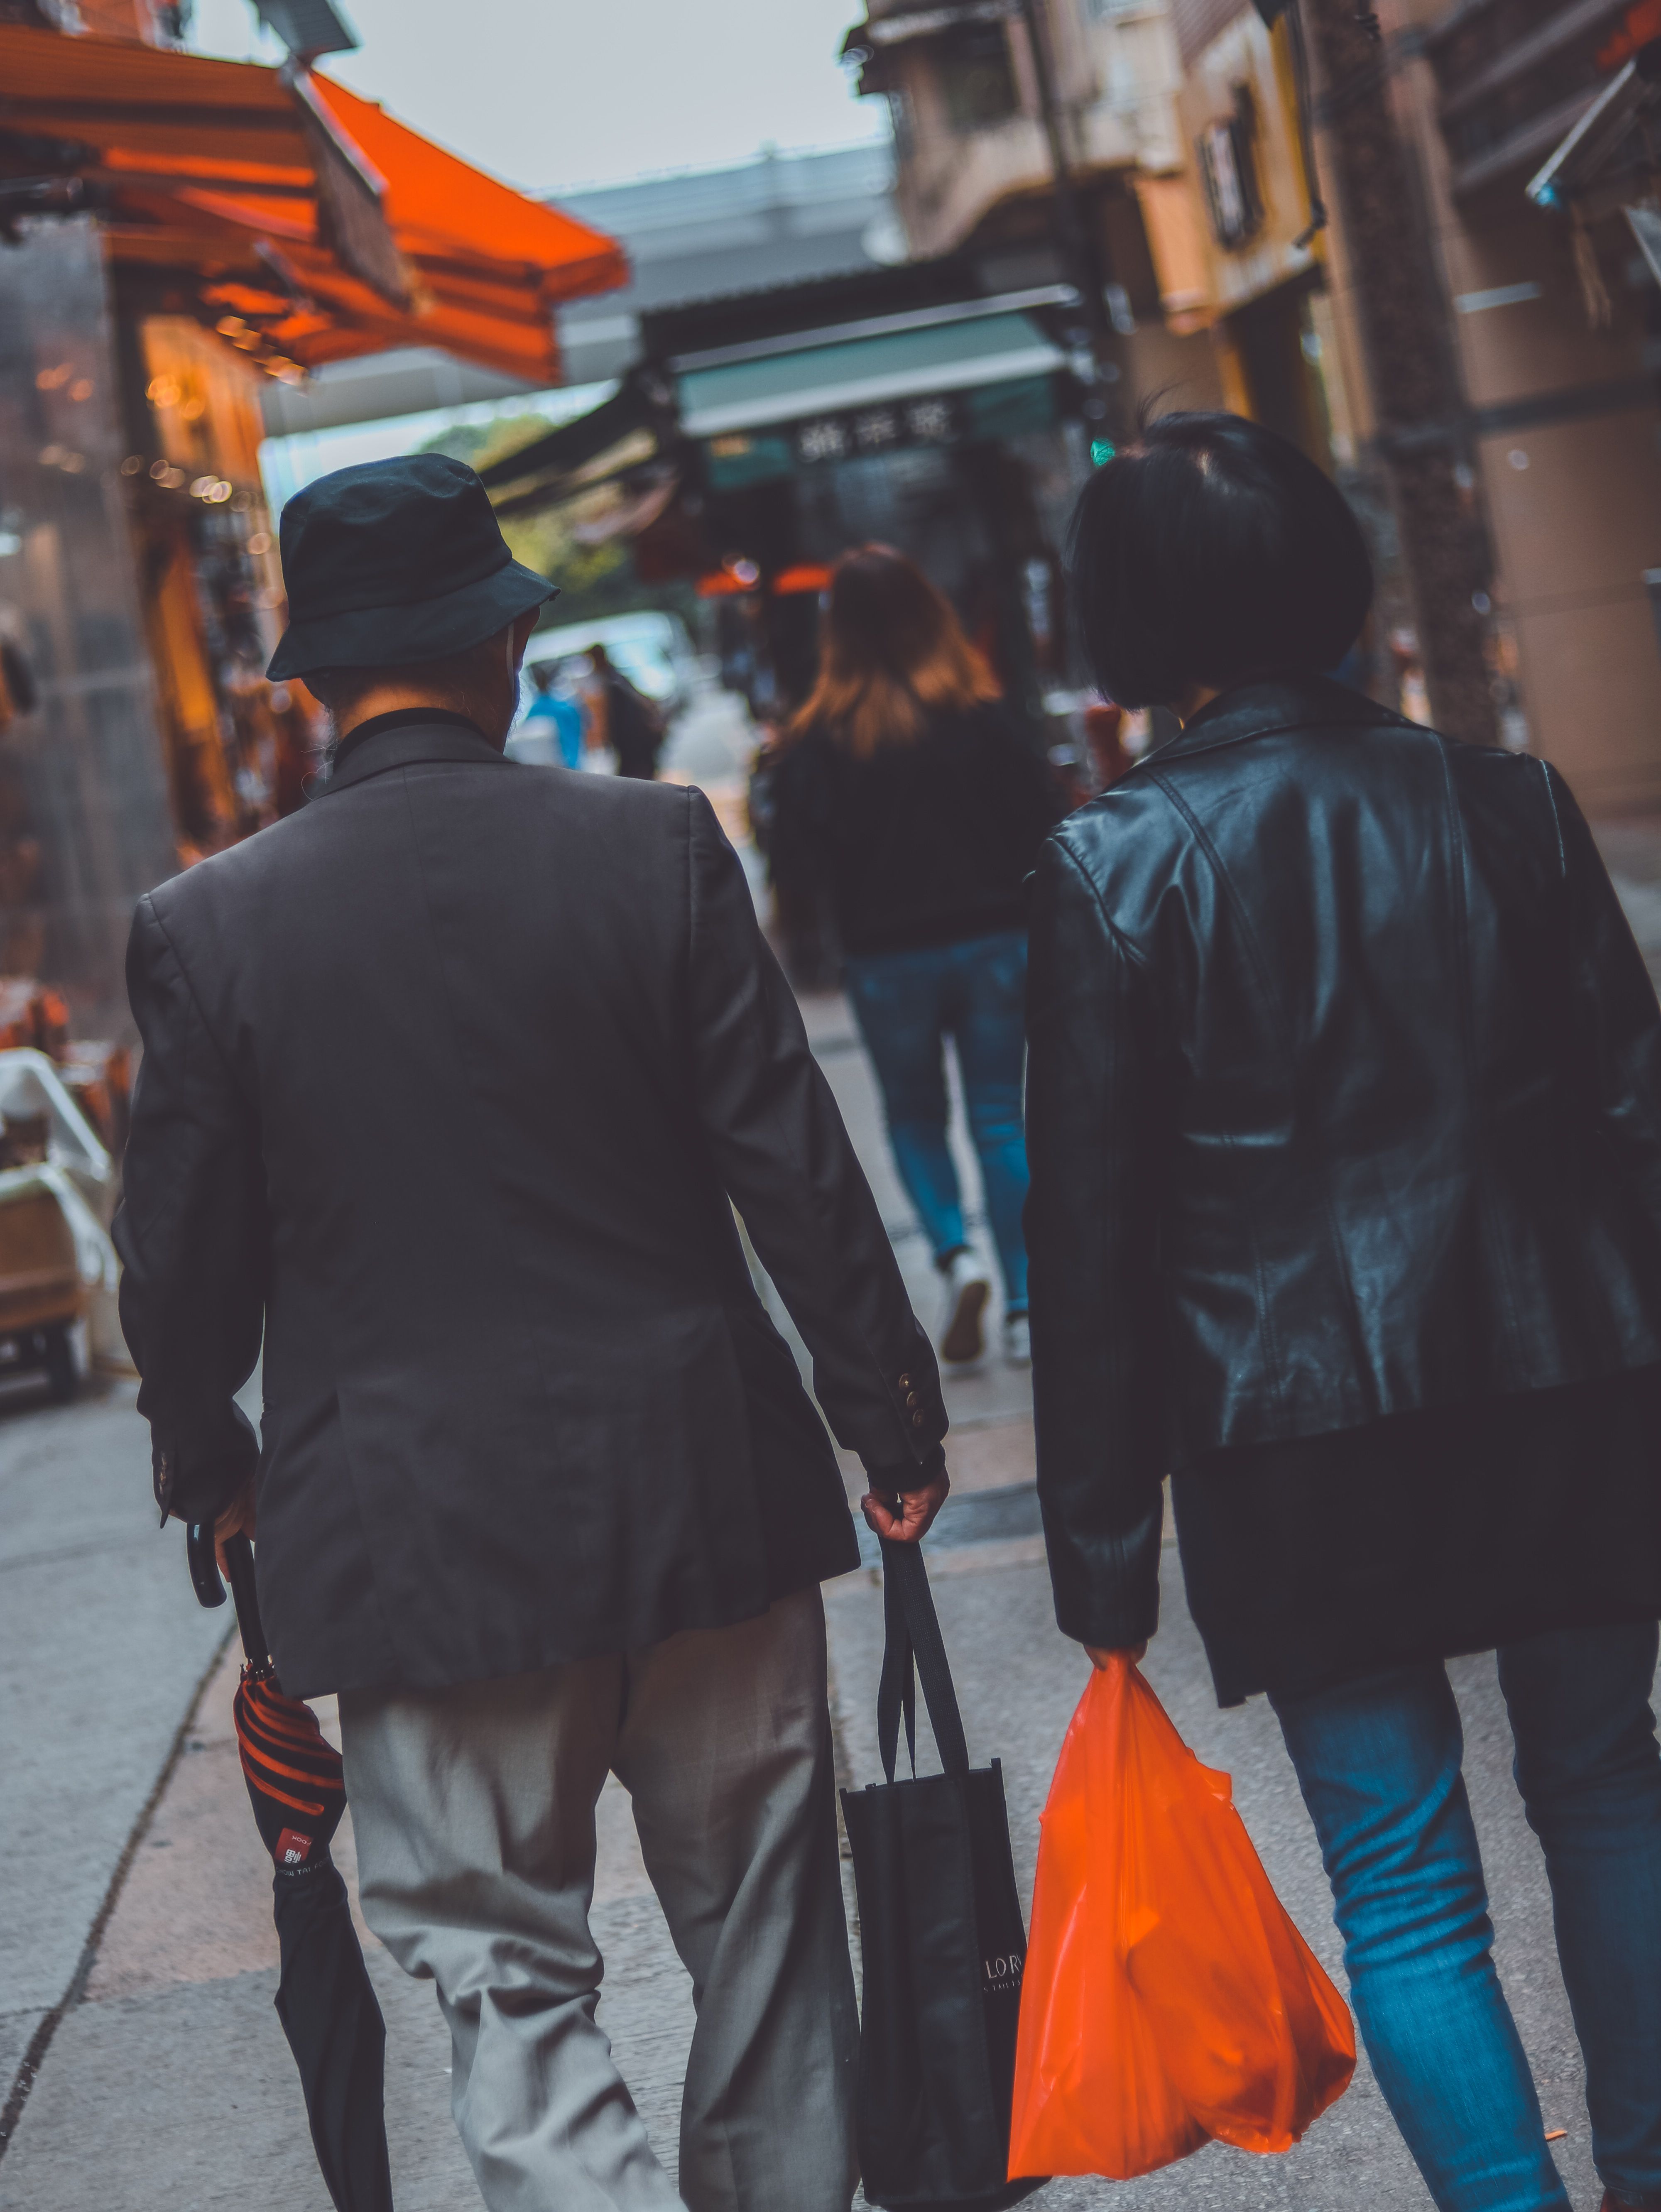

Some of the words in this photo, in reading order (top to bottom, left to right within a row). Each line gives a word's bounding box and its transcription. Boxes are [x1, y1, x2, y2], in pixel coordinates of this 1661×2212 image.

[292, 1835, 311, 1845] FOOK
[284, 1849, 301, 1863] 福
[297, 1867, 311, 1875] TAI
